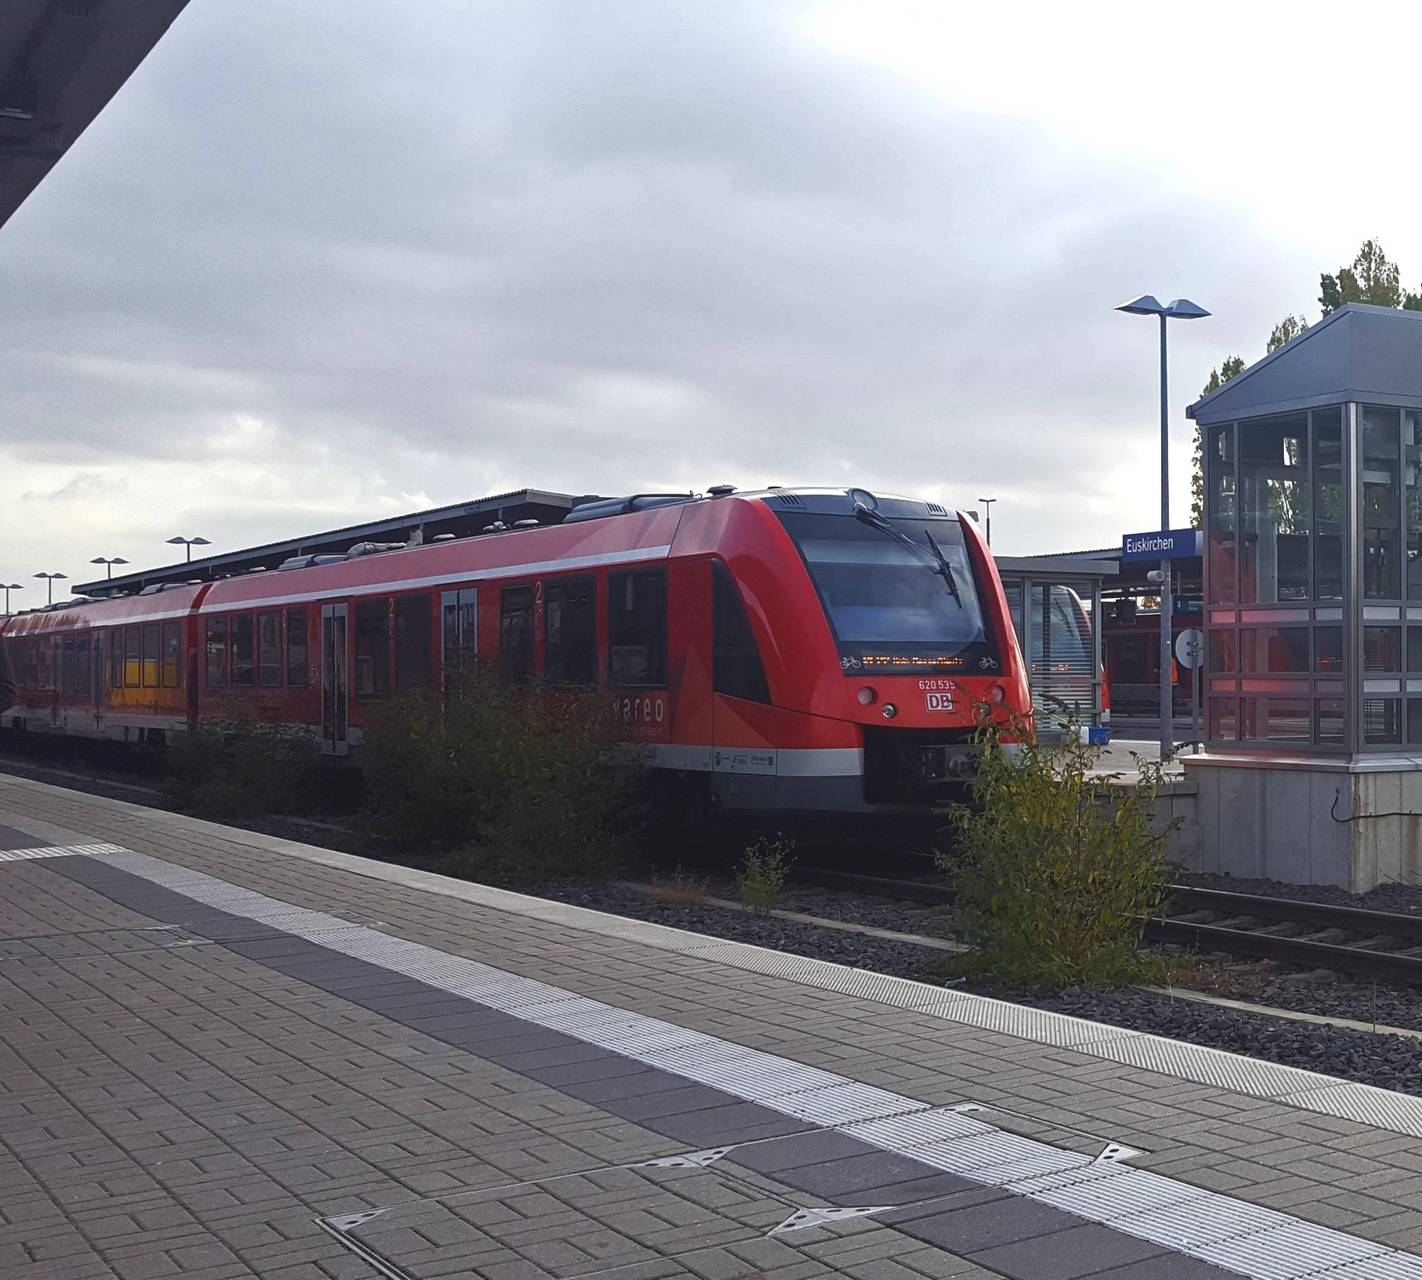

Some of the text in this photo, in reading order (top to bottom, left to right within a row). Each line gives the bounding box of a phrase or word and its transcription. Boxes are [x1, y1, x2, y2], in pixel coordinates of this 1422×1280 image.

[1126, 536, 1174, 553] Euskirchen
[918, 680, 936, 690] 620
[927, 693, 952, 709] DB
